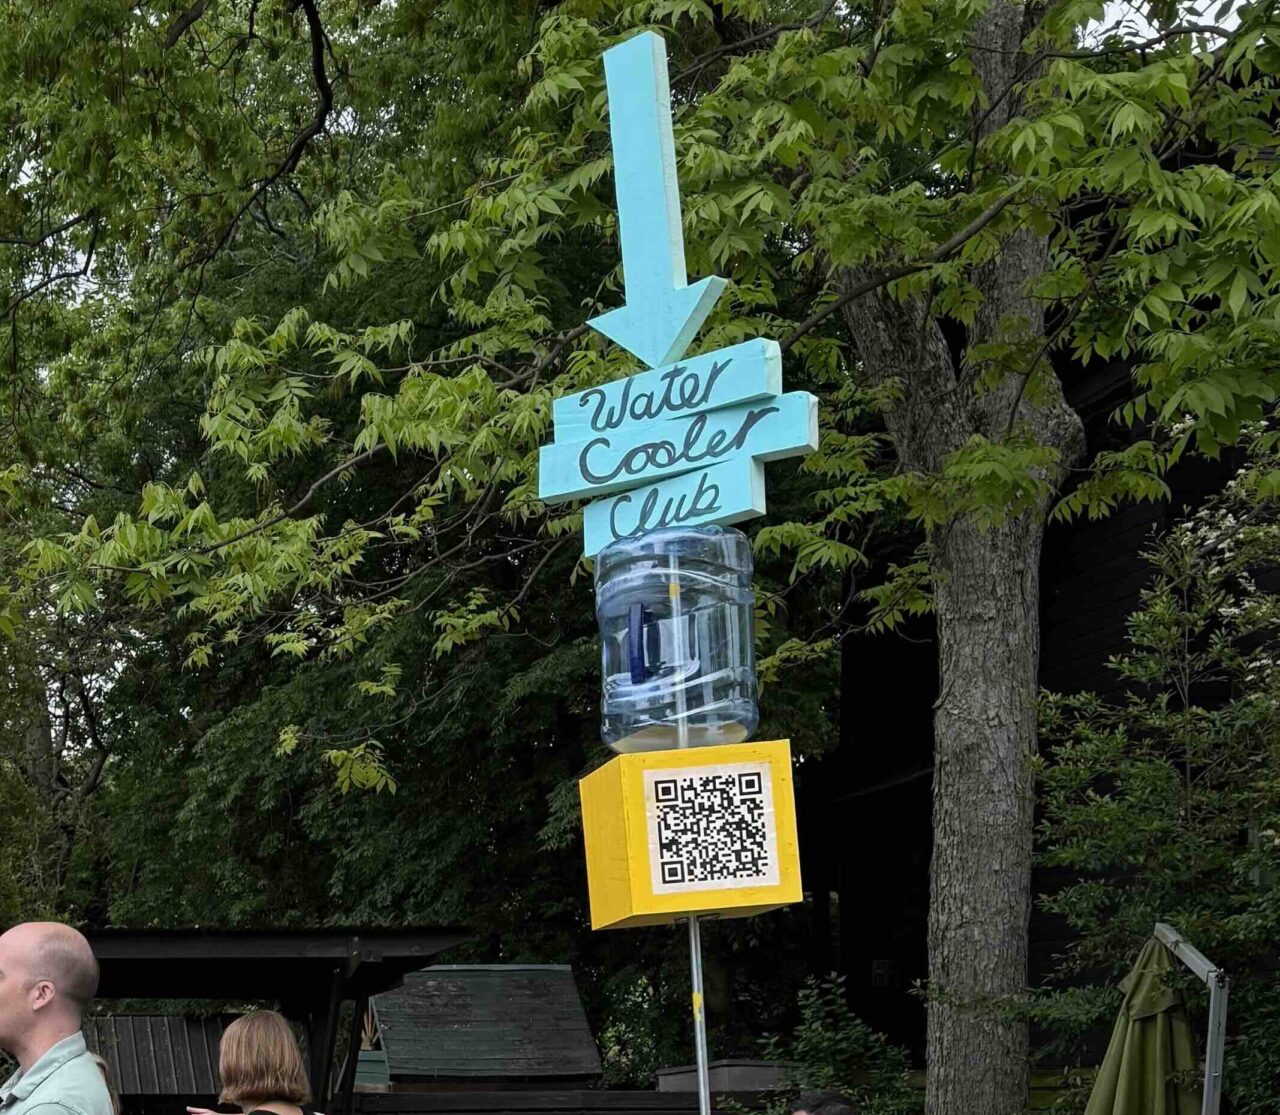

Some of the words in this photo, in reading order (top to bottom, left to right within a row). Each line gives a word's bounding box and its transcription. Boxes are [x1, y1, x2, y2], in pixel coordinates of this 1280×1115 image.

[578, 357, 733, 432] Water
[578, 406, 780, 485] Cooler
[609, 473, 722, 540] Club
